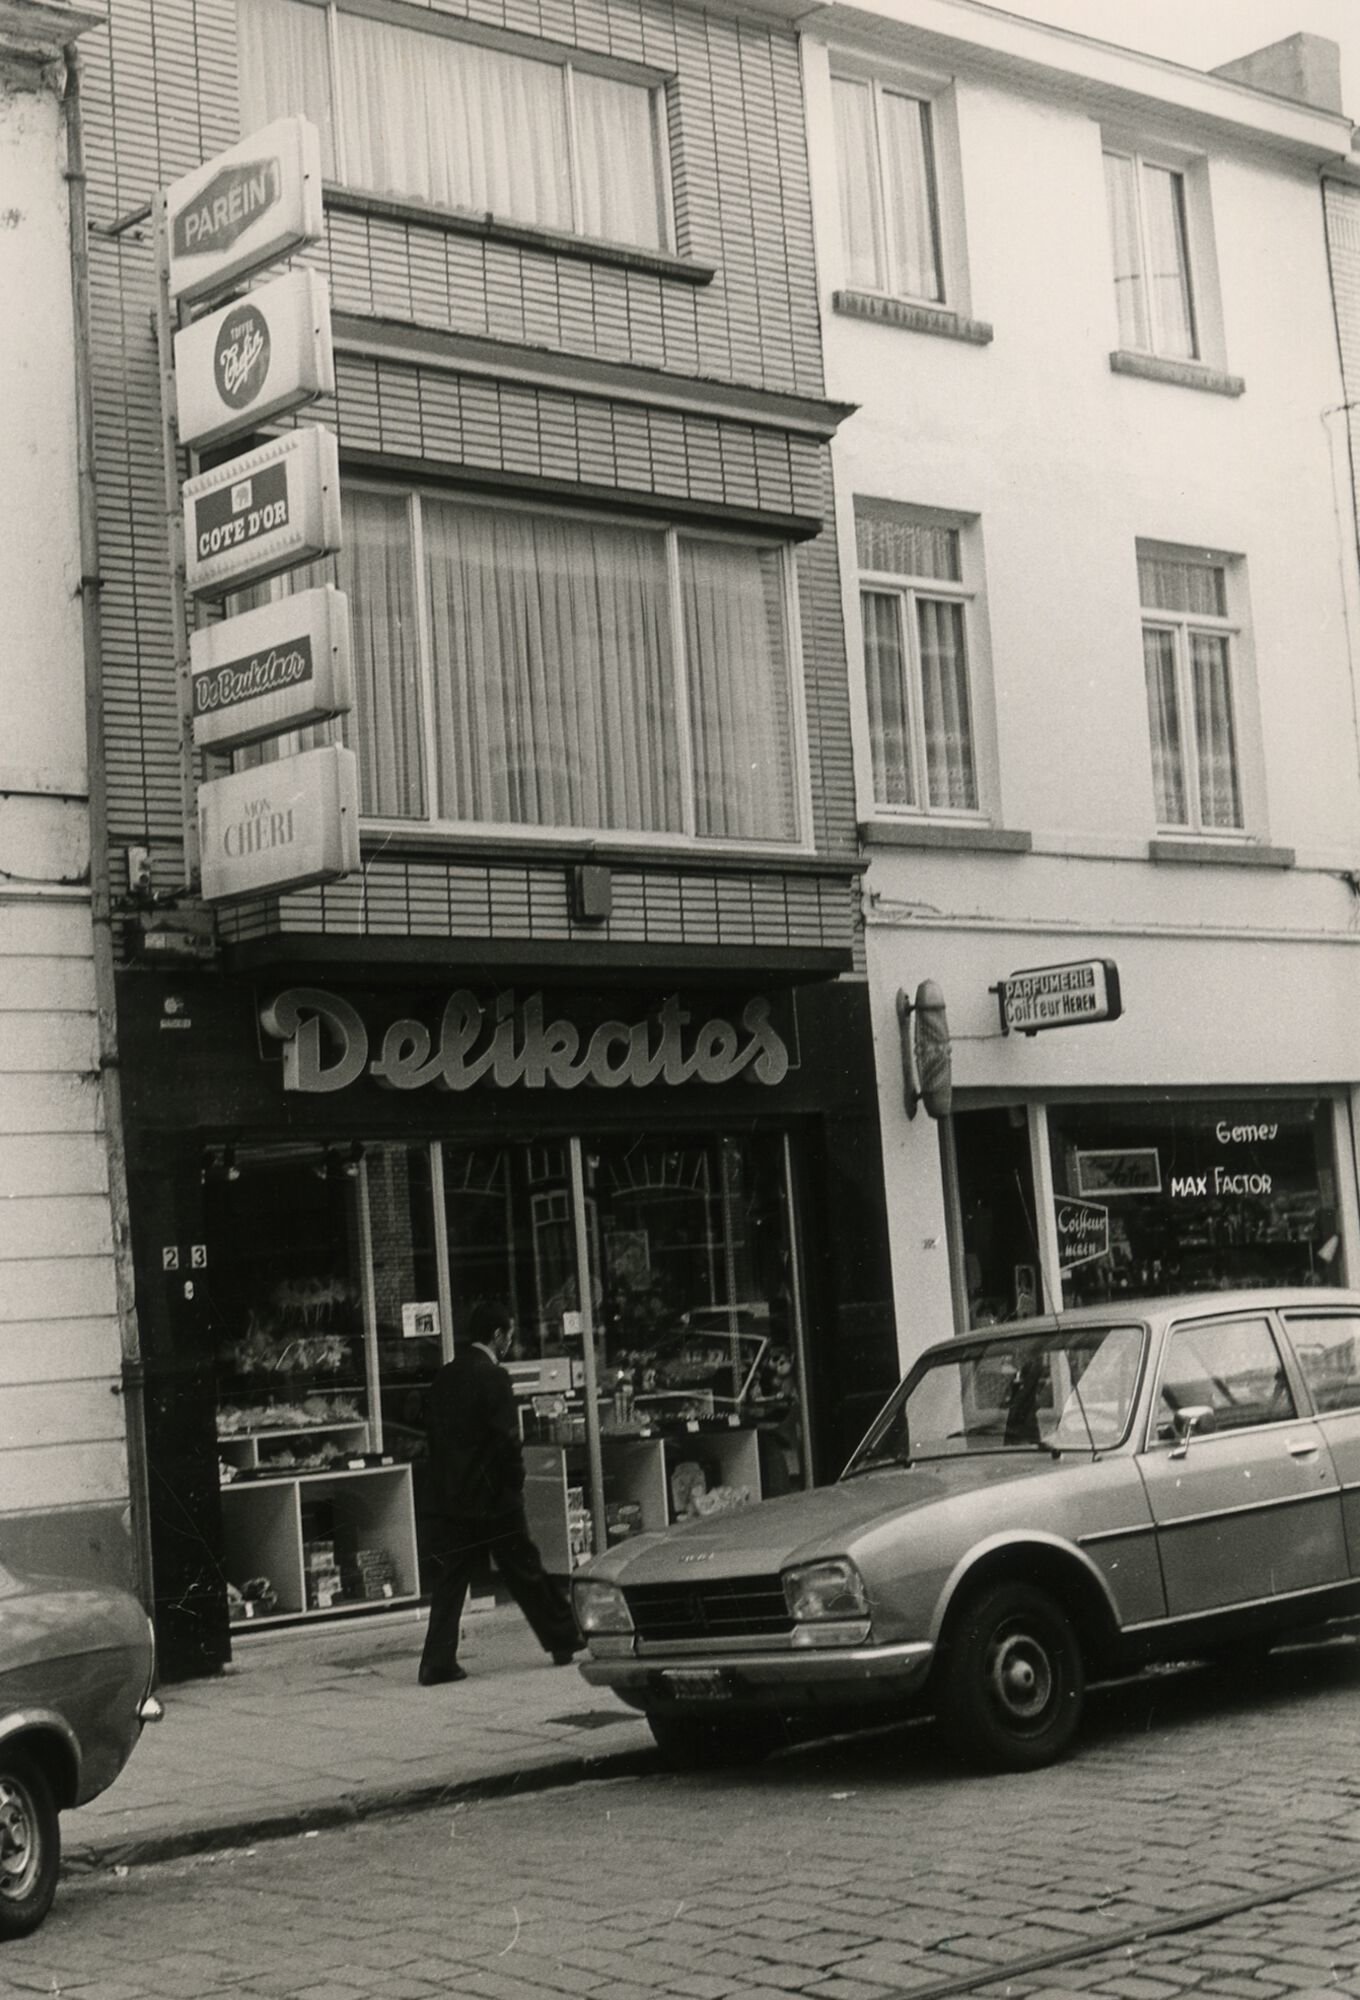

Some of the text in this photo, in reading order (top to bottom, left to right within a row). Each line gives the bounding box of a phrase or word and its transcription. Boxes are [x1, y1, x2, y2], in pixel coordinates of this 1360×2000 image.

[185, 174, 266, 247] PAREIN
[199, 500, 287, 556] COTE D'OR
[1005, 969, 1094, 998] PARFUMERIE
[1005, 994, 1061, 1023] Coiffeur
[261, 987, 788, 1092] Delikates
[1216, 1121, 1278, 1144] Gemey
[1171, 1166, 1272, 1197] MAX FACTOR
[1058, 1206, 1106, 1239] Coiffeur
